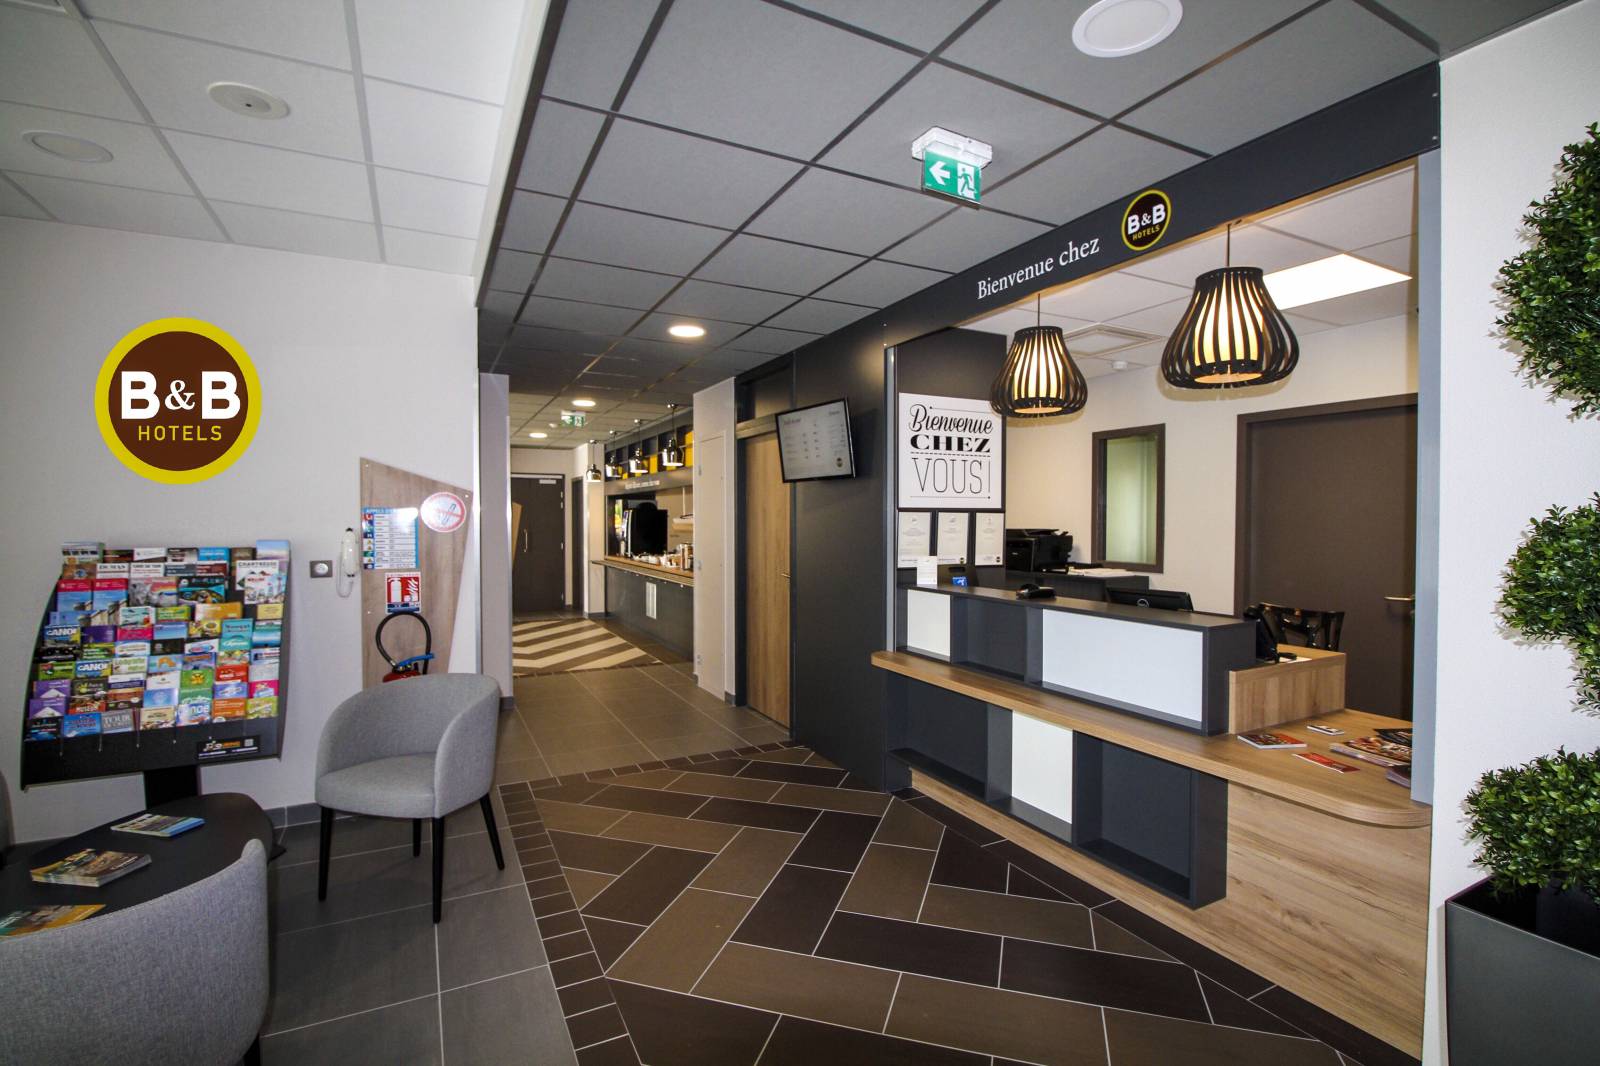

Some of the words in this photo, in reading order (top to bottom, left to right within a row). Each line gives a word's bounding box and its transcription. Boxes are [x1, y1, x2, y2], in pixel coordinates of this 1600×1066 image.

[1132, 224, 1161, 241] HOTELS
[977, 256, 1054, 300] Bienvenue
[1059, 237, 1101, 266] chez
[908, 403, 994, 434] Bienvenue
[138, 425, 222, 441] HOTELS
[910, 434, 991, 453] CHEZ
